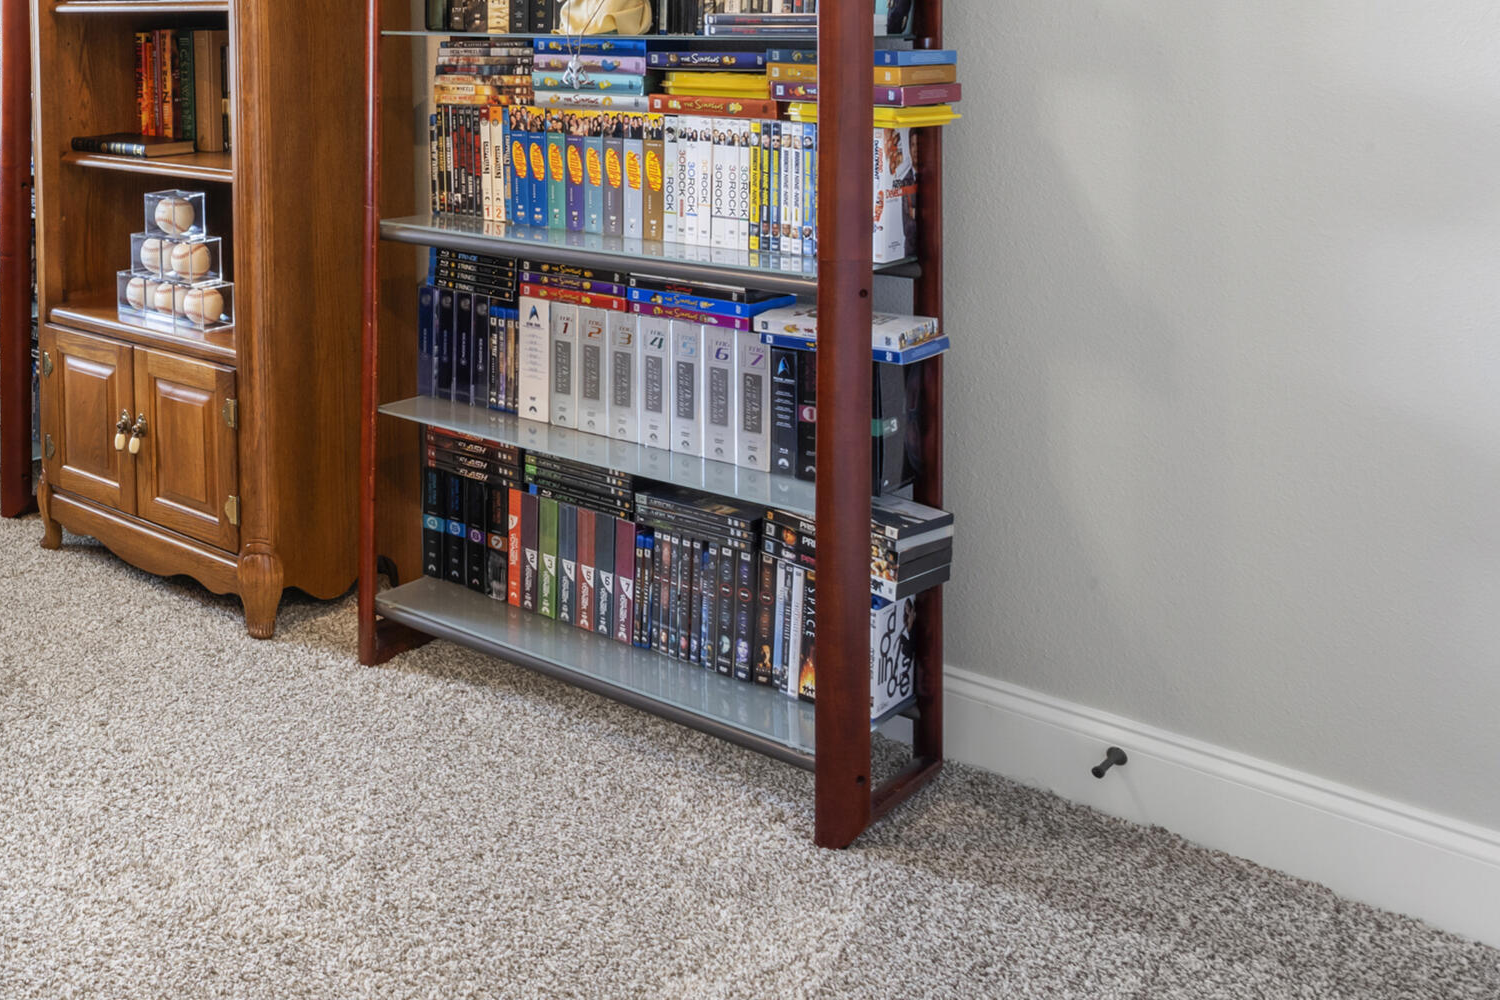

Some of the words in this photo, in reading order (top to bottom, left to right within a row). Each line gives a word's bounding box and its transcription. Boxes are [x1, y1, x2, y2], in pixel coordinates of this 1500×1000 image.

[691, 53, 720, 64] SIMPSONS
[162, 92, 171, 104] Z
[573, 95, 599, 105] SIMPSONS
[694, 99, 724, 110] SIMPSONS
[514, 143, 526, 178] Seinfeld
[532, 145, 544, 180] Seinfeld
[550, 146, 563, 182] Seinfeld
[569, 148, 582, 184] Seinfeld
[588, 150, 601, 186] Seinfeld
[608, 151, 621, 188] Seinfeld
[628, 153, 641, 190] Seinfeld
[648, 153, 662, 191] Seinfeld
[484, 207, 490, 217] 1
[496, 209, 502, 218] 2
[674, 309, 699, 321] SIMPSONS
[562, 322, 568, 334] 1
[587, 326, 602, 338] 2
[619, 332, 632, 345] 3
[650, 336, 664, 349] 4
[682, 342, 695, 355] 5
[715, 347, 729, 360] 6
[750, 354, 764, 366] 7
[459, 442, 486, 454] FLASH
[459, 456, 487, 468] FLASH
[459, 469, 488, 481] FLASH
[802, 536, 816, 548] PRI
[528, 554, 535, 563] 2
[547, 559, 554, 569] 3
[586, 570, 592, 581] 5
[605, 576, 611, 586] 6
[624, 582, 630, 593] 7
[805, 587, 816, 638] SPACE
